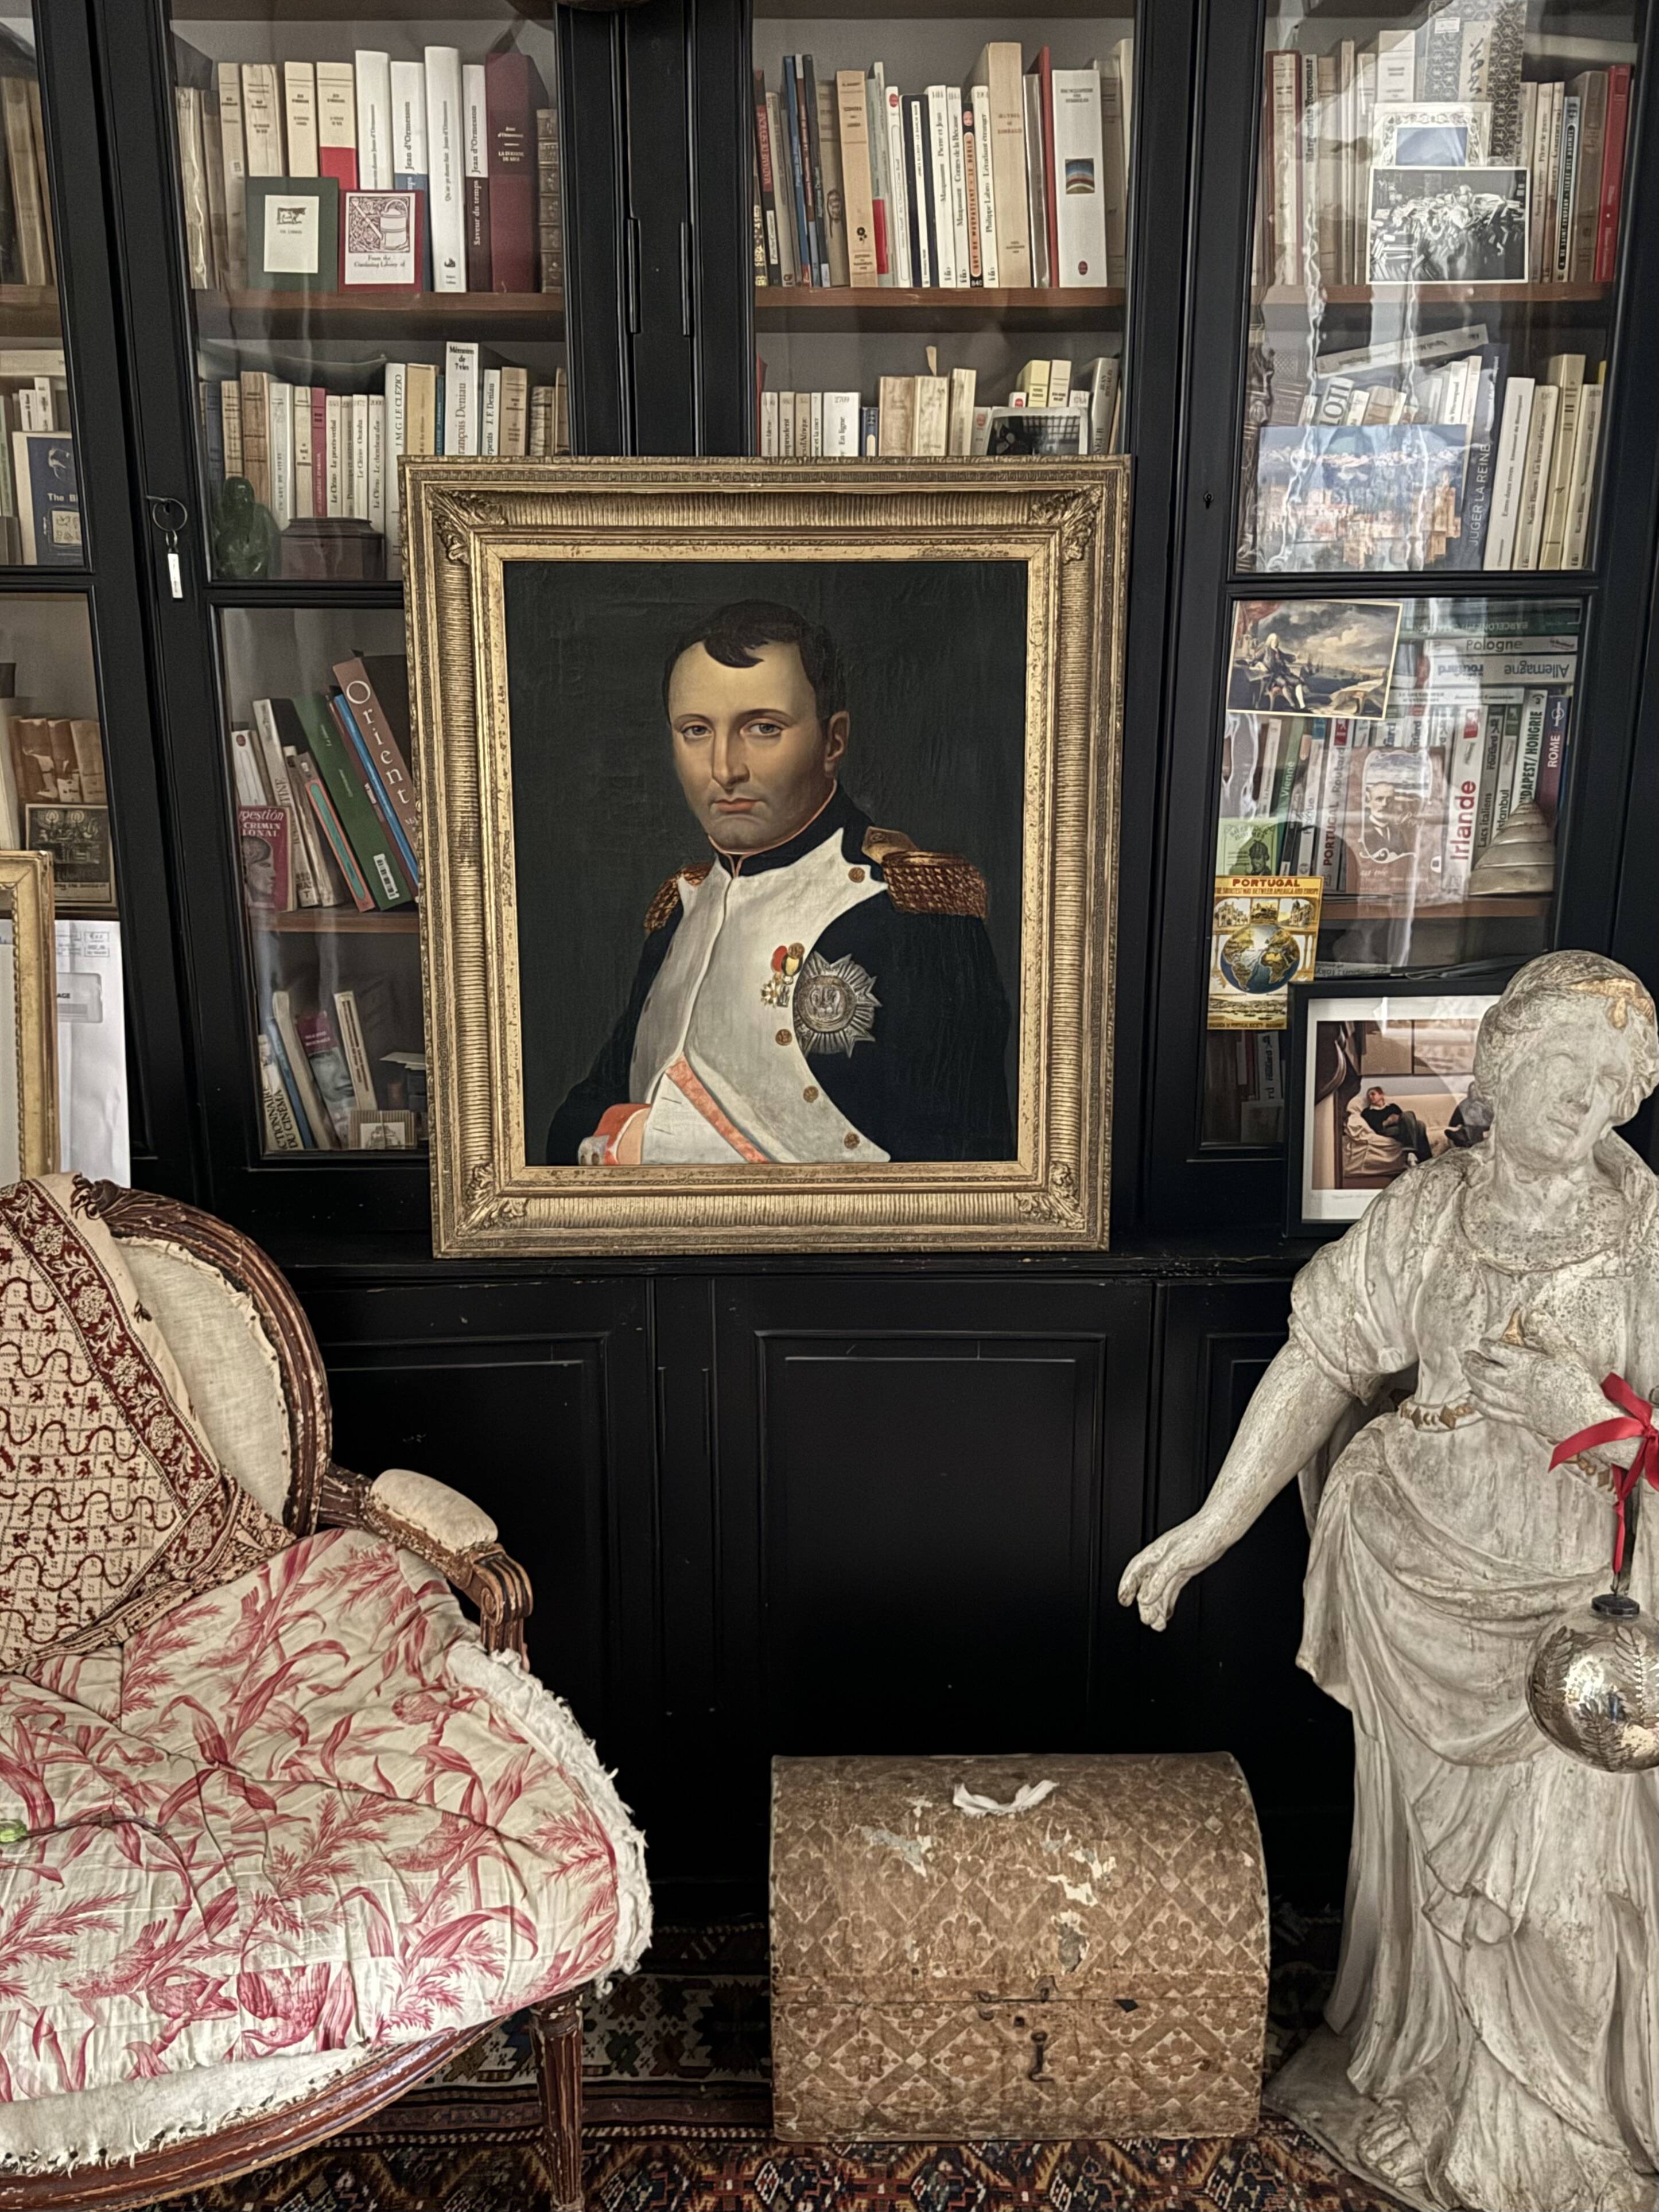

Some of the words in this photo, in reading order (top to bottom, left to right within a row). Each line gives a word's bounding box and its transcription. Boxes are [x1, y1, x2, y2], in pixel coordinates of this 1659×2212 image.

[1303, 58, 1314, 107] Yourcenar
[403, 102, 411, 149] d'Ormesson
[469, 106, 479, 152] d'Ormesson
[951, 115, 959, 142] Bécasse
[980, 113, 989, 142] étranger
[1304, 108, 1316, 163] Marguerite
[405, 150, 414, 170] Jean
[471, 153, 480, 174] Jean
[762, 150, 771, 185] MADAME
[472, 181, 481, 204] temps
[955, 188, 964, 227] Maupassant
[985, 204, 993, 233] Philippe
[472, 212, 481, 246] Saveur
[449, 345, 474, 354] Mémoires
[454, 383, 466, 418] Deniau
[487, 383, 495, 409] Deniau
[395, 408, 402, 419] LE
[838, 417, 847, 434] ligne
[329, 420, 337, 458] procès-verbal
[396, 432, 402, 440] M
[455, 420, 468, 454] rançois
[485, 432, 494, 454] rpents
[783, 418, 791, 456] mprudent
[838, 435, 845, 445] En
[331, 460, 337, 468] Le
[1475, 443, 1491, 483] REINE
[1534, 445, 1543, 464] ferme
[357, 470, 363, 478] Le
[374, 465, 380, 473] Le
[1506, 466, 1514, 482] rives
[1533, 465, 1540, 475] La
[47, 493, 64, 502] The
[331, 495, 337, 503] Le
[1472, 486, 1485, 502] LA
[1503, 483, 1512, 499] deux
[1529, 479, 1538, 502] Blixen
[374, 500, 380, 509] Le
[1527, 504, 1536, 525] Karen
[1469, 504, 1483, 546] JUGER
[1466, 640, 1522, 652] Pologne
[1504, 661, 1569, 678] Allemagne
[346, 680, 410, 804] Orient
[1524, 711, 1543, 755] HONGRIE
[1547, 734, 1561, 768] ROME
[1280, 761, 1295, 798] Vienne
[1518, 756, 1534, 803] UDAPEST/
[1323, 803, 1339, 866] PORTUGAL
[1331, 747, 1346, 794] Routard
[1479, 792, 1492, 826] italiens
[1494, 789, 1510, 831] Istanbul
[1449, 780, 1476, 860] Irlande
[1477, 827, 1488, 848] Lacs
[263, 1088, 286, 1149] CTIONNAIRE
[274, 1089, 292, 1131] CINÉMA
[287, 1133, 298, 1148] DU
